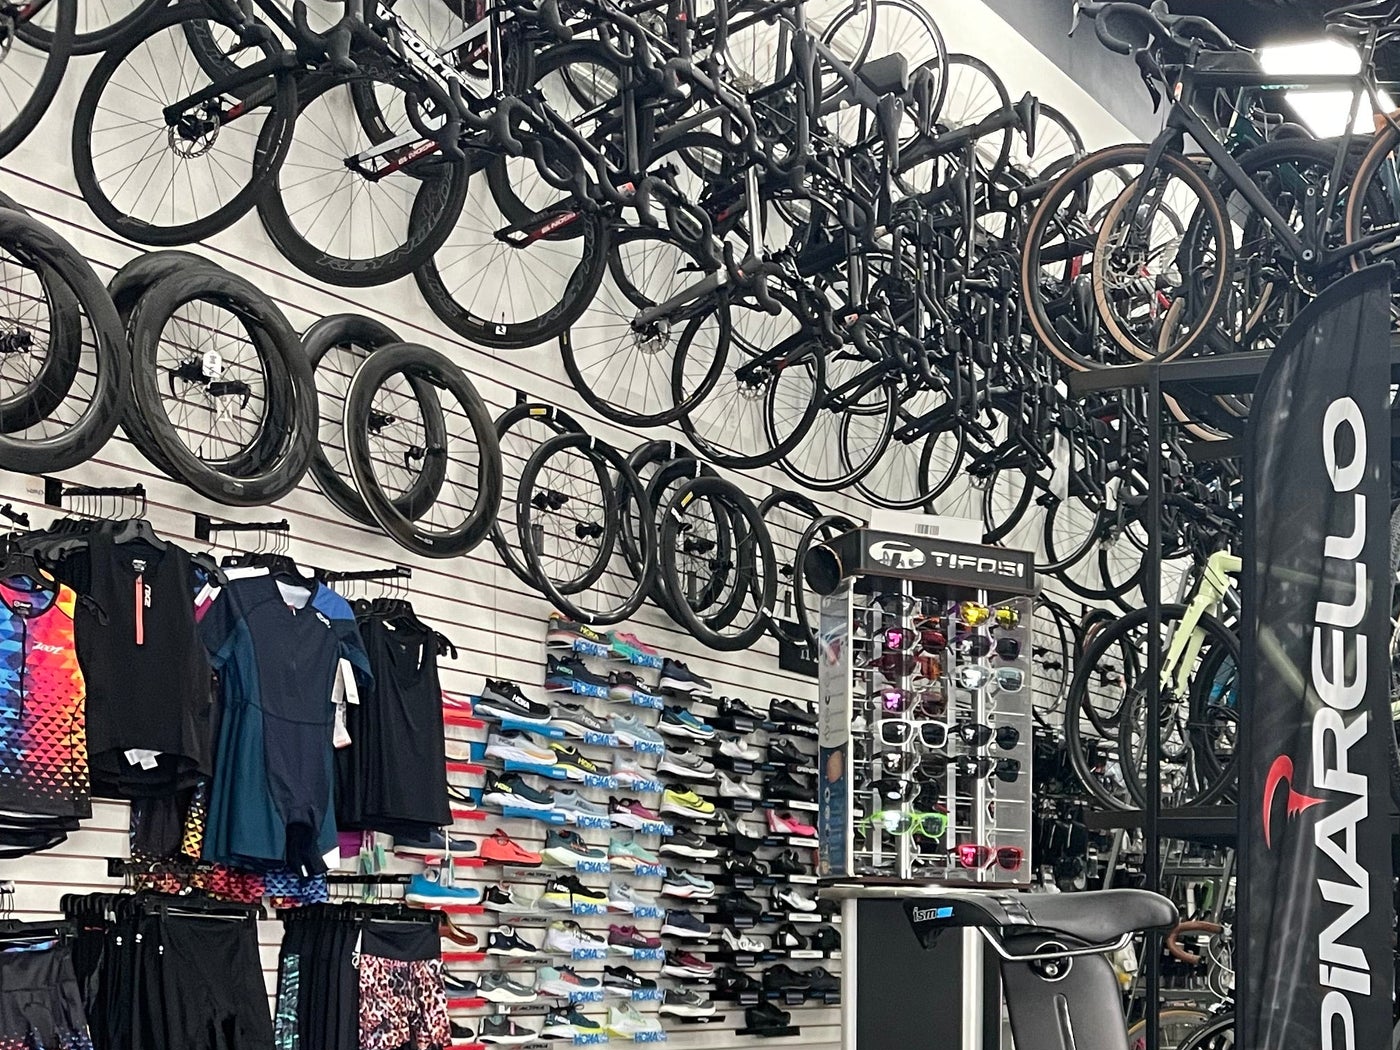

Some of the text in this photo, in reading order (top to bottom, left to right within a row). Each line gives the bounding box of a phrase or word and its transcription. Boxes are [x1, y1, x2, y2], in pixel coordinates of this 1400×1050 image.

[931, 551, 1024, 578] TIFOSI
[512, 694, 530, 709] HOKA
[913, 907, 936, 922] ism
